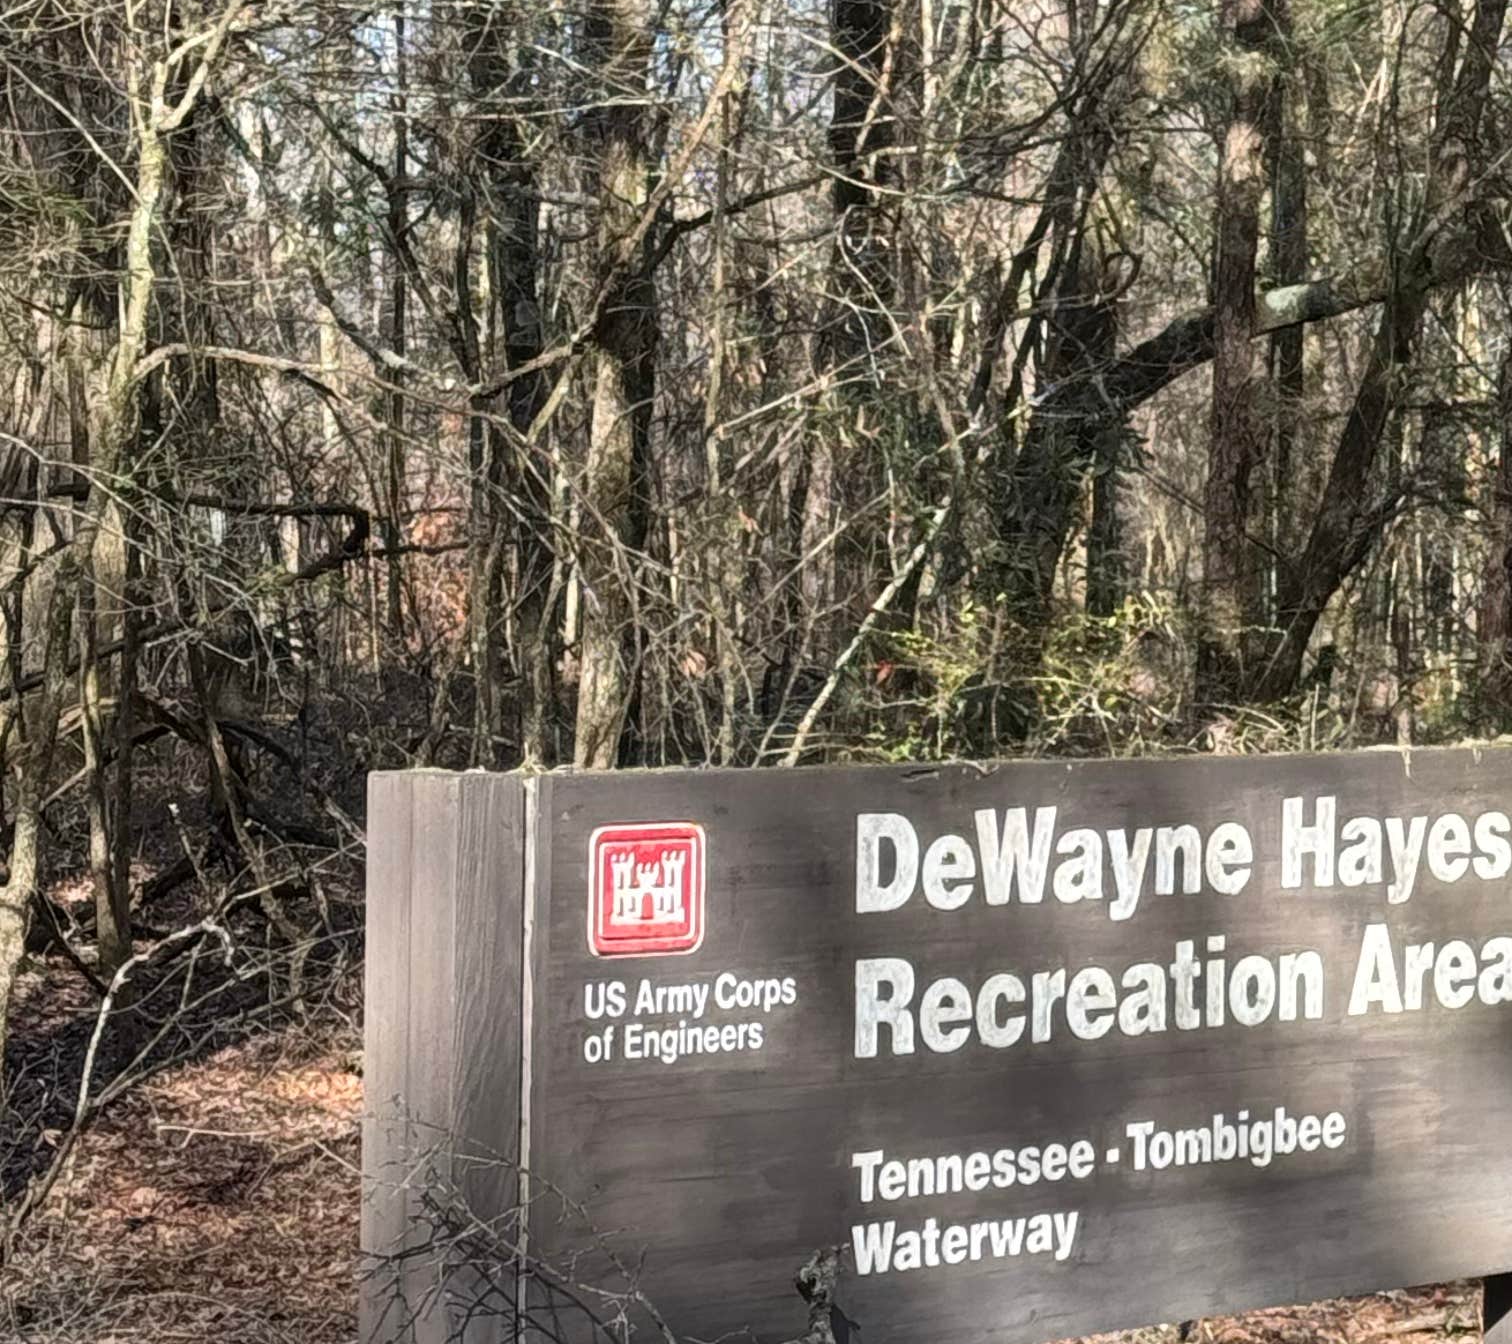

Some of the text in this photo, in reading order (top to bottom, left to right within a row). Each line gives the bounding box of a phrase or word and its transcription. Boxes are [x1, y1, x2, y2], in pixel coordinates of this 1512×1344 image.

[855, 795, 1512, 921] DeWayne Hayes
[584, 972, 796, 1019] US Army Corps
[854, 935, 1323, 1059] Recreation
[584, 1020, 763, 1064] of Engineers
[852, 1211, 1079, 1276] Waterway
